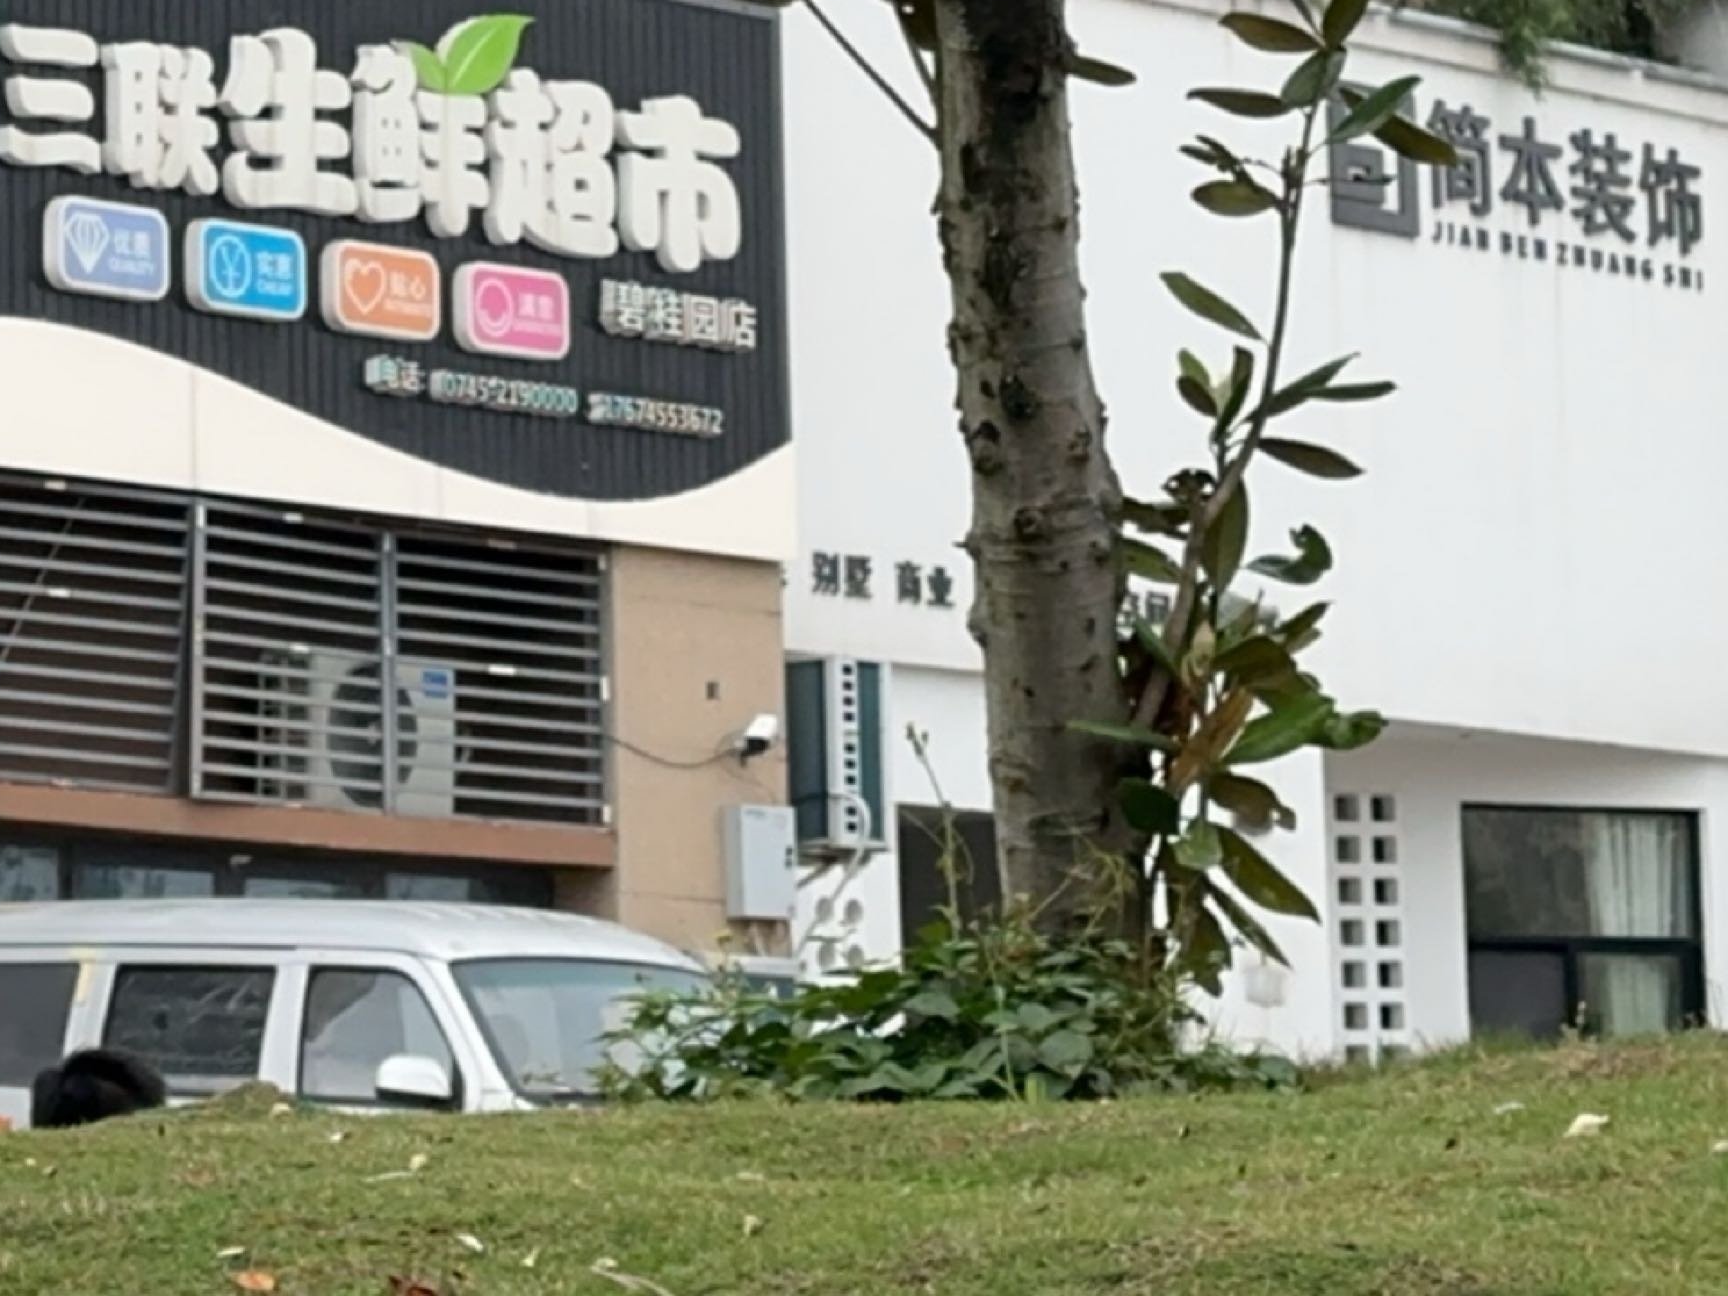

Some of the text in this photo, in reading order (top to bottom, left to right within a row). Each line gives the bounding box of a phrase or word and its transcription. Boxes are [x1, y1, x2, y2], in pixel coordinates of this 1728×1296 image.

[1426, 99, 1703, 259] 简本装饰
[1431, 220, 1491, 252] JIAN
[604, 279, 757, 351] 碧桂园店
[811, 550, 956, 608] 别墅 商业
